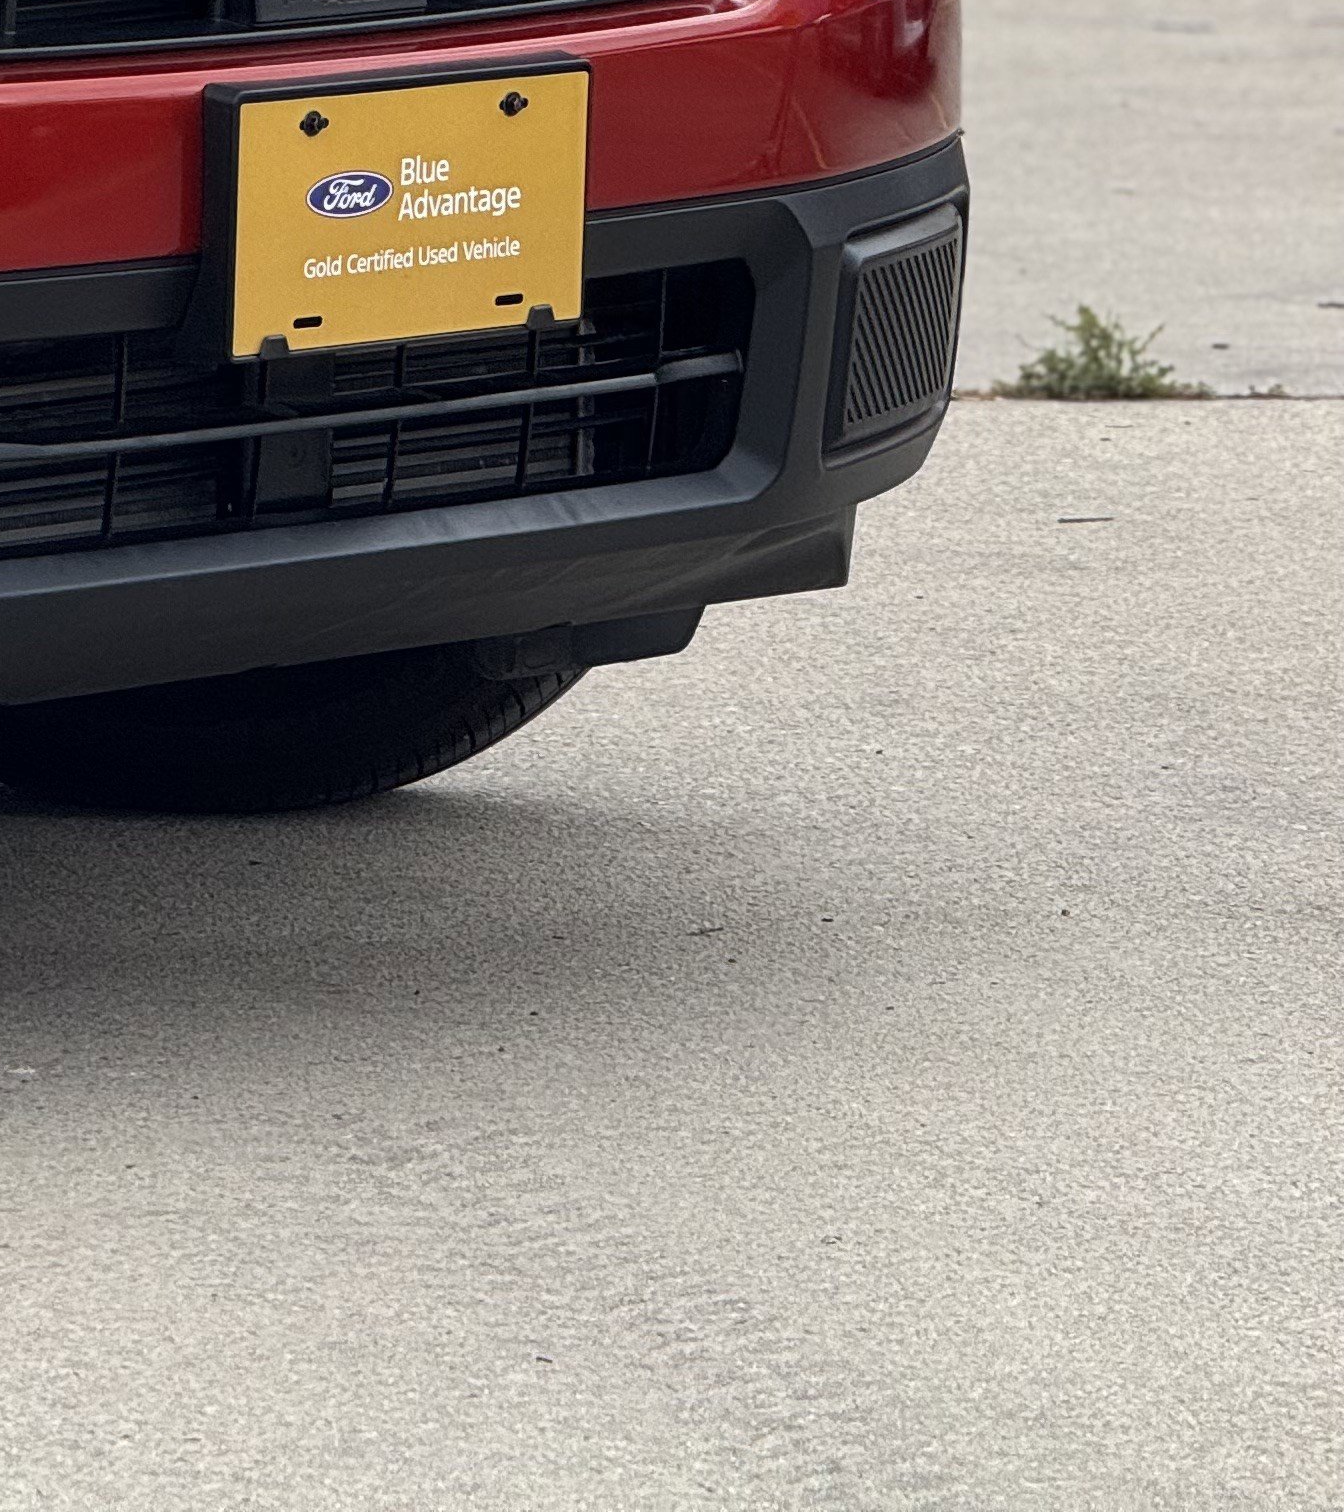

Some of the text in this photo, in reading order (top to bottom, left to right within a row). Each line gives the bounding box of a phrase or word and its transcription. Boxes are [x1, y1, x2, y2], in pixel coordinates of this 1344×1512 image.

[400, 155, 450, 186] Blue
[322, 178, 377, 211] Ford
[398, 185, 522, 221] Advantage
[303, 234, 521, 279] Gold Certified Used Vehicle
